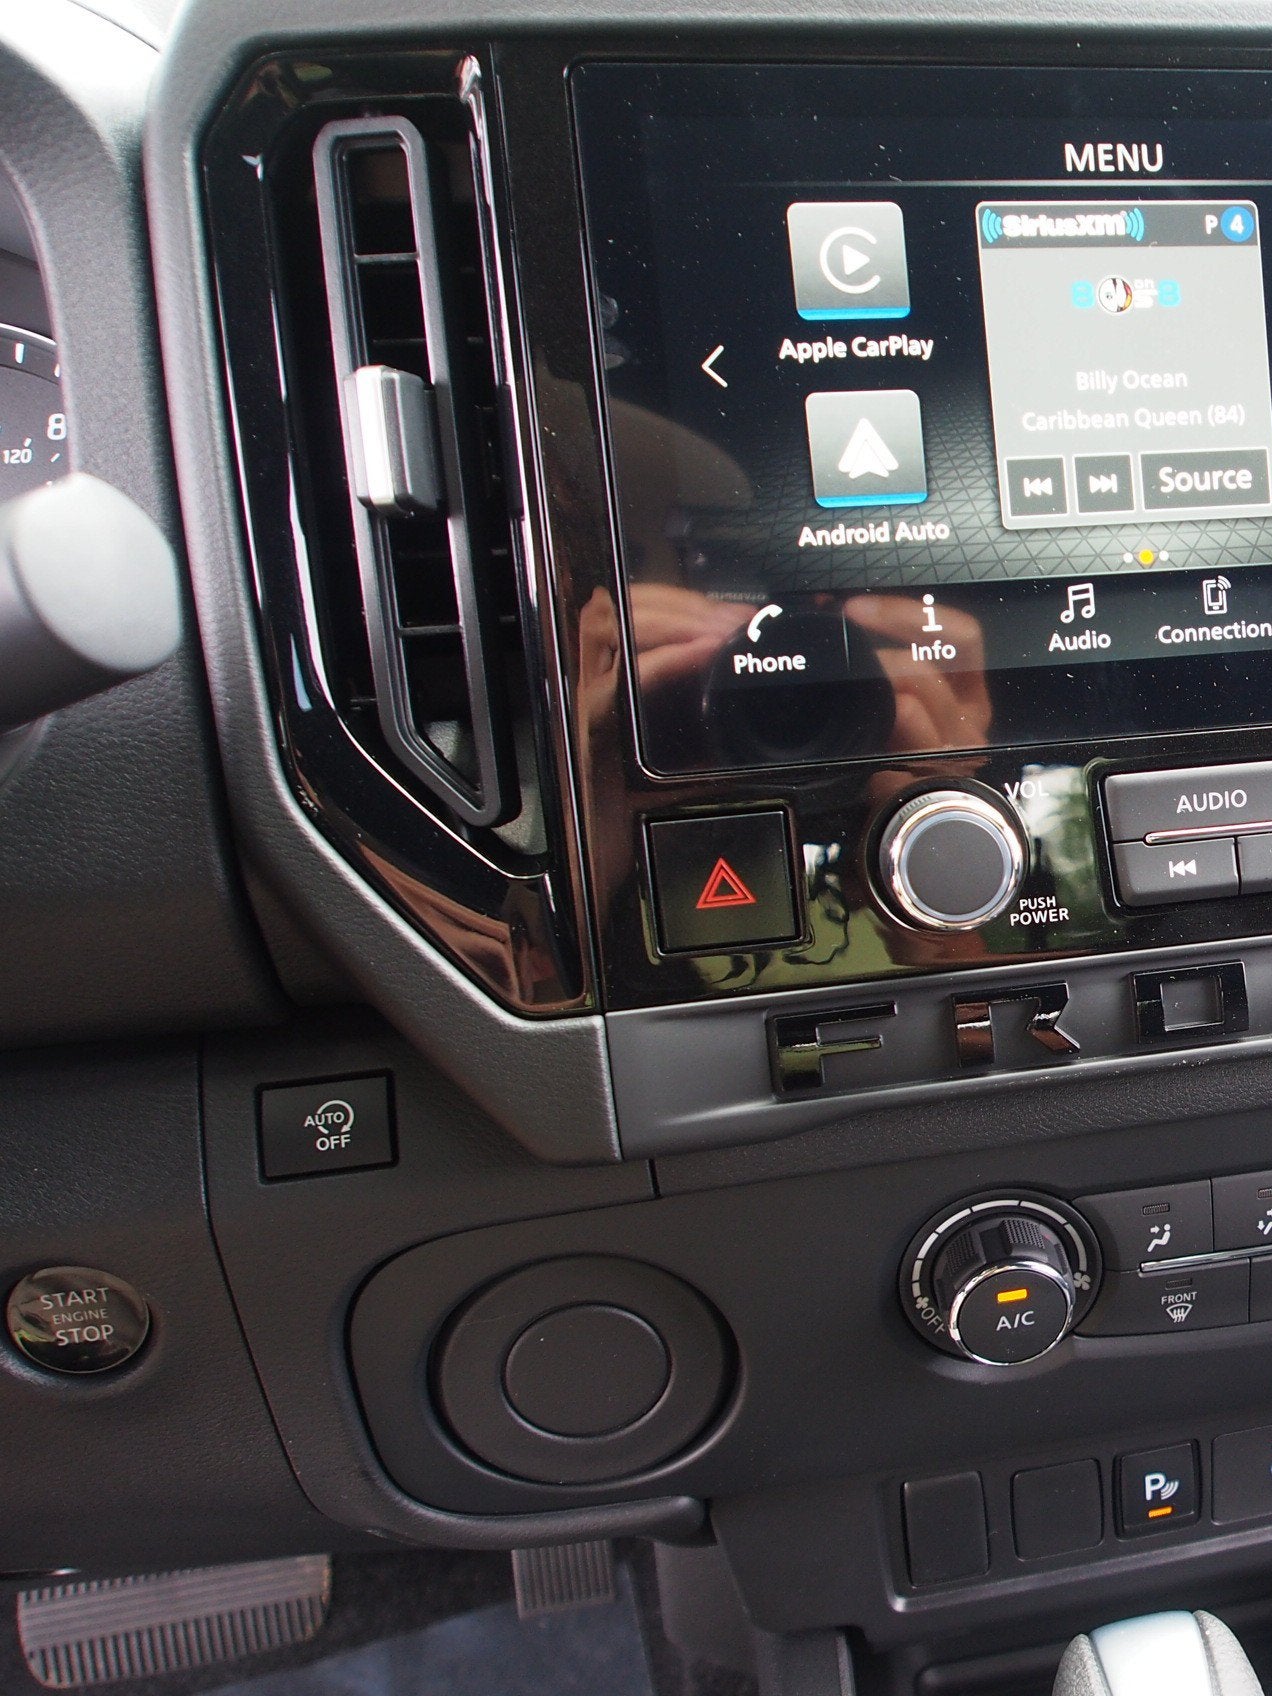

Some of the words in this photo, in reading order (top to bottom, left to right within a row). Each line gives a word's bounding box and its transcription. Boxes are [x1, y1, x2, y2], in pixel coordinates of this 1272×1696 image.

[1064, 143, 1163, 173] MENU
[1204, 214, 1219, 235] P
[1230, 213, 1245, 235] 4
[778, 336, 848, 364] Apple
[851, 334, 934, 361] CarPlay
[1075, 369, 1118, 395] Billy
[1122, 369, 1189, 390] Ocean
[46, 412, 67, 440] 8
[1021, 409, 1130, 432] Caribbean
[1134, 407, 1202, 431] Queen
[1207, 403, 1246, 428] (84)
[2, 447, 33, 465] 120
[1158, 465, 1253, 494] Source
[797, 521, 891, 547] Android
[895, 520, 951, 542] Auto
[911, 639, 957, 663] Info
[1047, 629, 1112, 654] Audio
[733, 651, 807, 675] Phone
[1003, 779, 1051, 801] VOL
[1175, 788, 1249, 815] AUDIO
[1018, 895, 1057, 912] PUSH
[1009, 906, 1070, 927] POWER
[304, 1111, 345, 1128] AUTO
[315, 1133, 352, 1152] OFF
[39, 1287, 109, 1310] START
[1160, 1291, 1199, 1306] FRONT
[52, 1307, 109, 1326] ENGINE
[996, 1310, 1036, 1333] A/C
[54, 1323, 115, 1348] STOP
